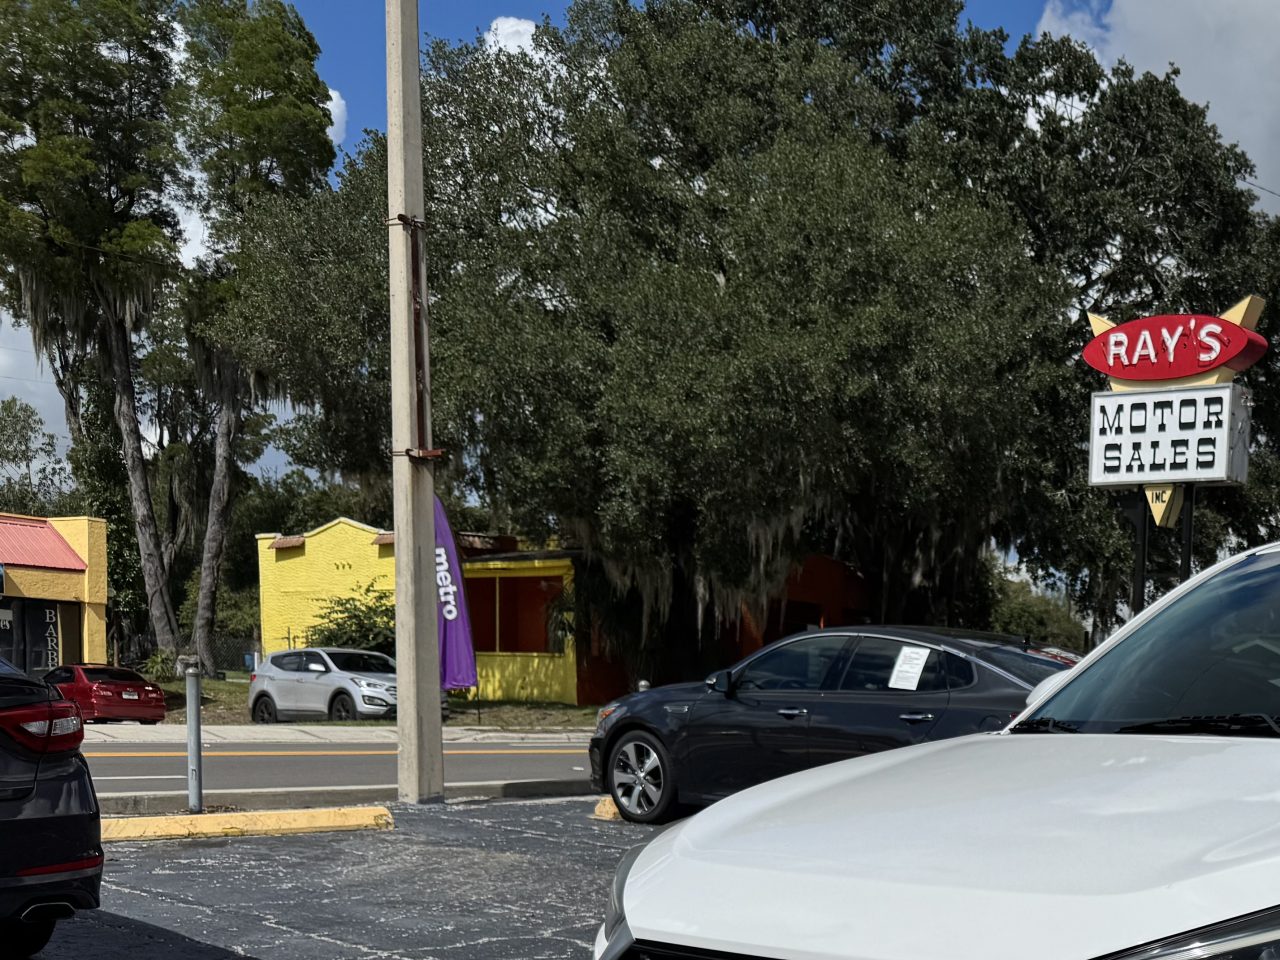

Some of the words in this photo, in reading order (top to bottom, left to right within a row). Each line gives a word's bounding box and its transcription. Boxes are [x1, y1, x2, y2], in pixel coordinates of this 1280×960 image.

[1107, 317, 1224, 367] RAY'S
[1099, 396, 1224, 436] MOTOR
[1103, 437, 1217, 475] SALES
[1151, 490, 1167, 505] INC
[435, 547, 458, 621] metro
